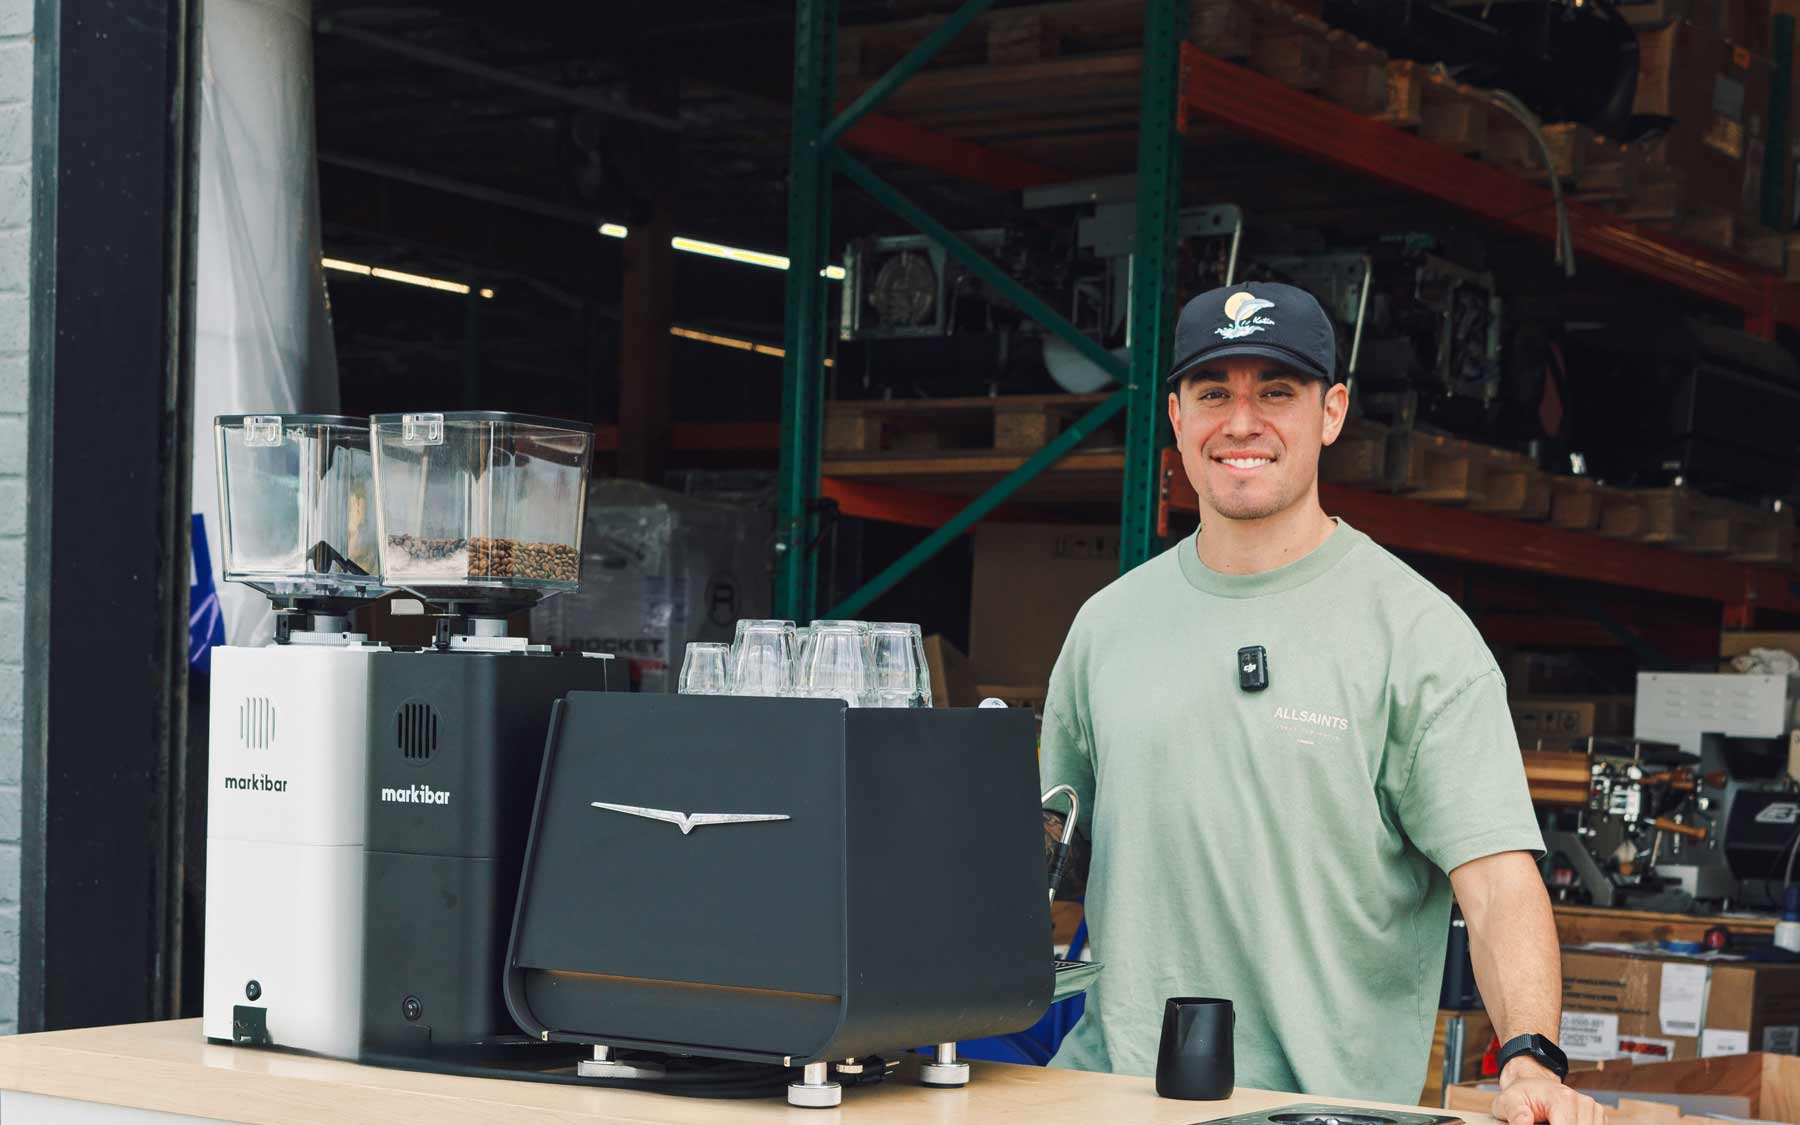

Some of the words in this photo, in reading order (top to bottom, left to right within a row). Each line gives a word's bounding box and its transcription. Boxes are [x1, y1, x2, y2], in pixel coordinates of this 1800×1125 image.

[1273, 706, 1349, 731] ALLSAINTS
[225, 773, 288, 792] markibar
[381, 784, 450, 804] markibar
